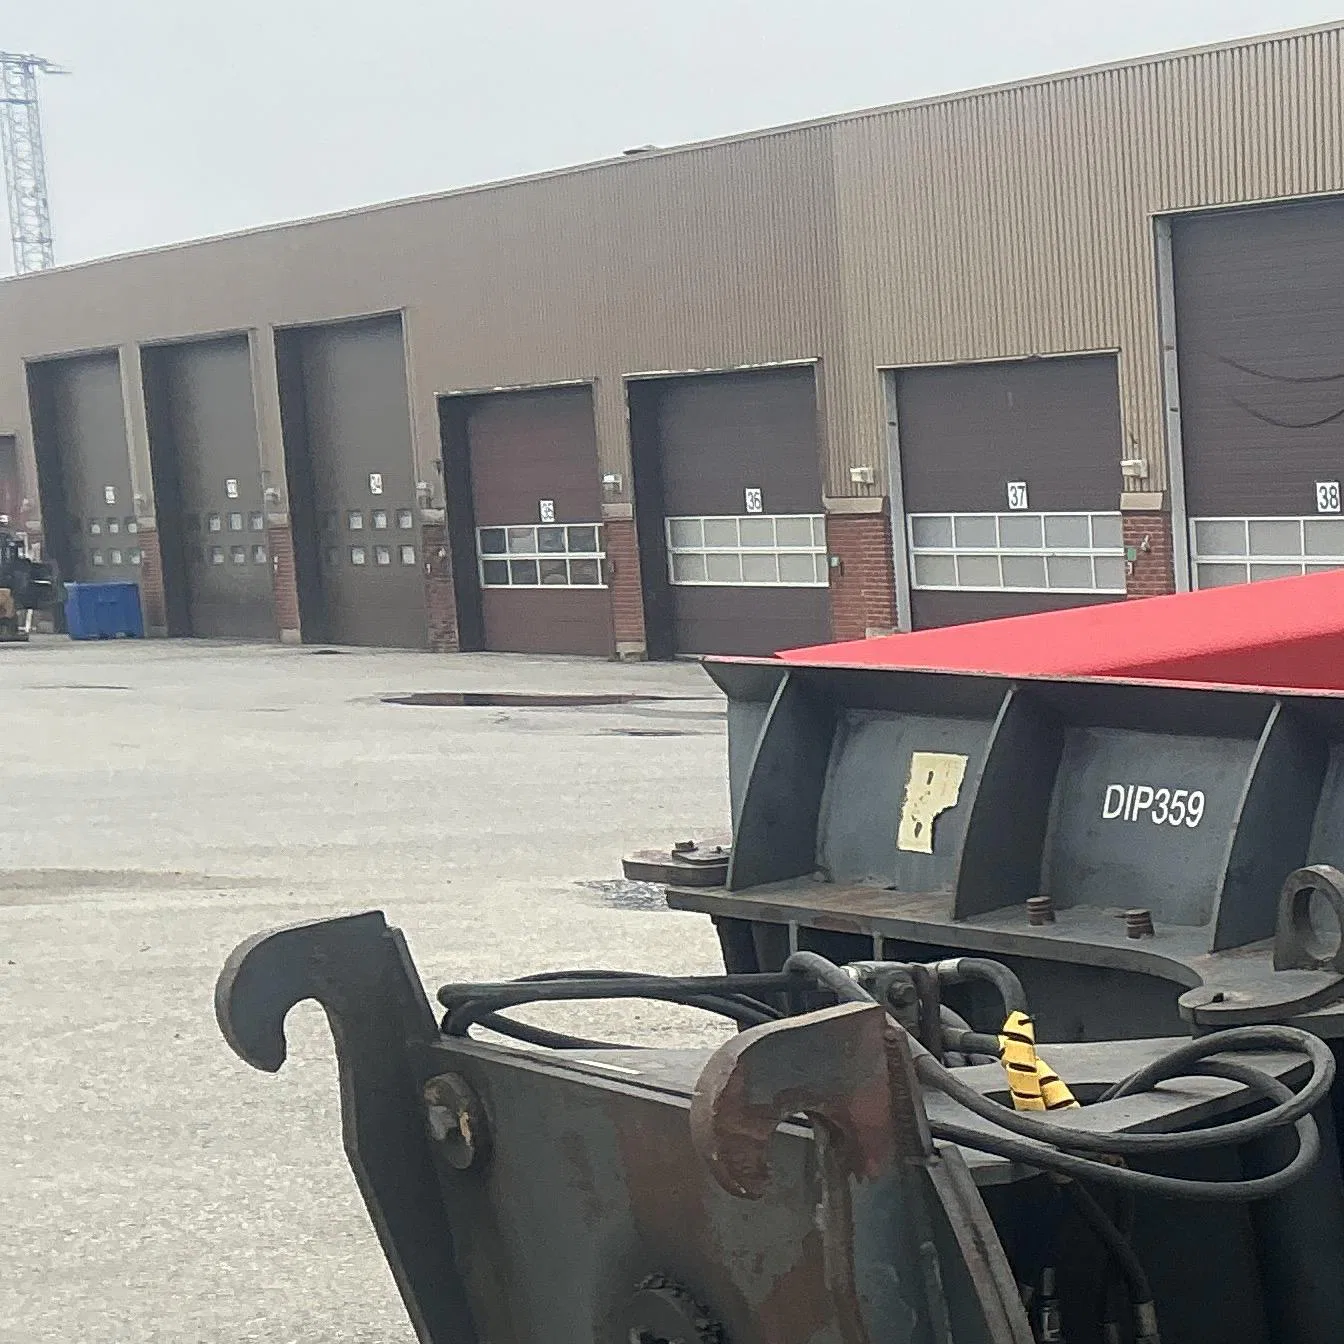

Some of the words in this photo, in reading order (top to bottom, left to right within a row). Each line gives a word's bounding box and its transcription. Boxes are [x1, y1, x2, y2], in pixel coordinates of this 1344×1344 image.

[748, 491, 761, 510] 36
[1010, 485, 1026, 507] 37
[1319, 485, 1339, 510] 38
[1102, 784, 1205, 828] DIP359
